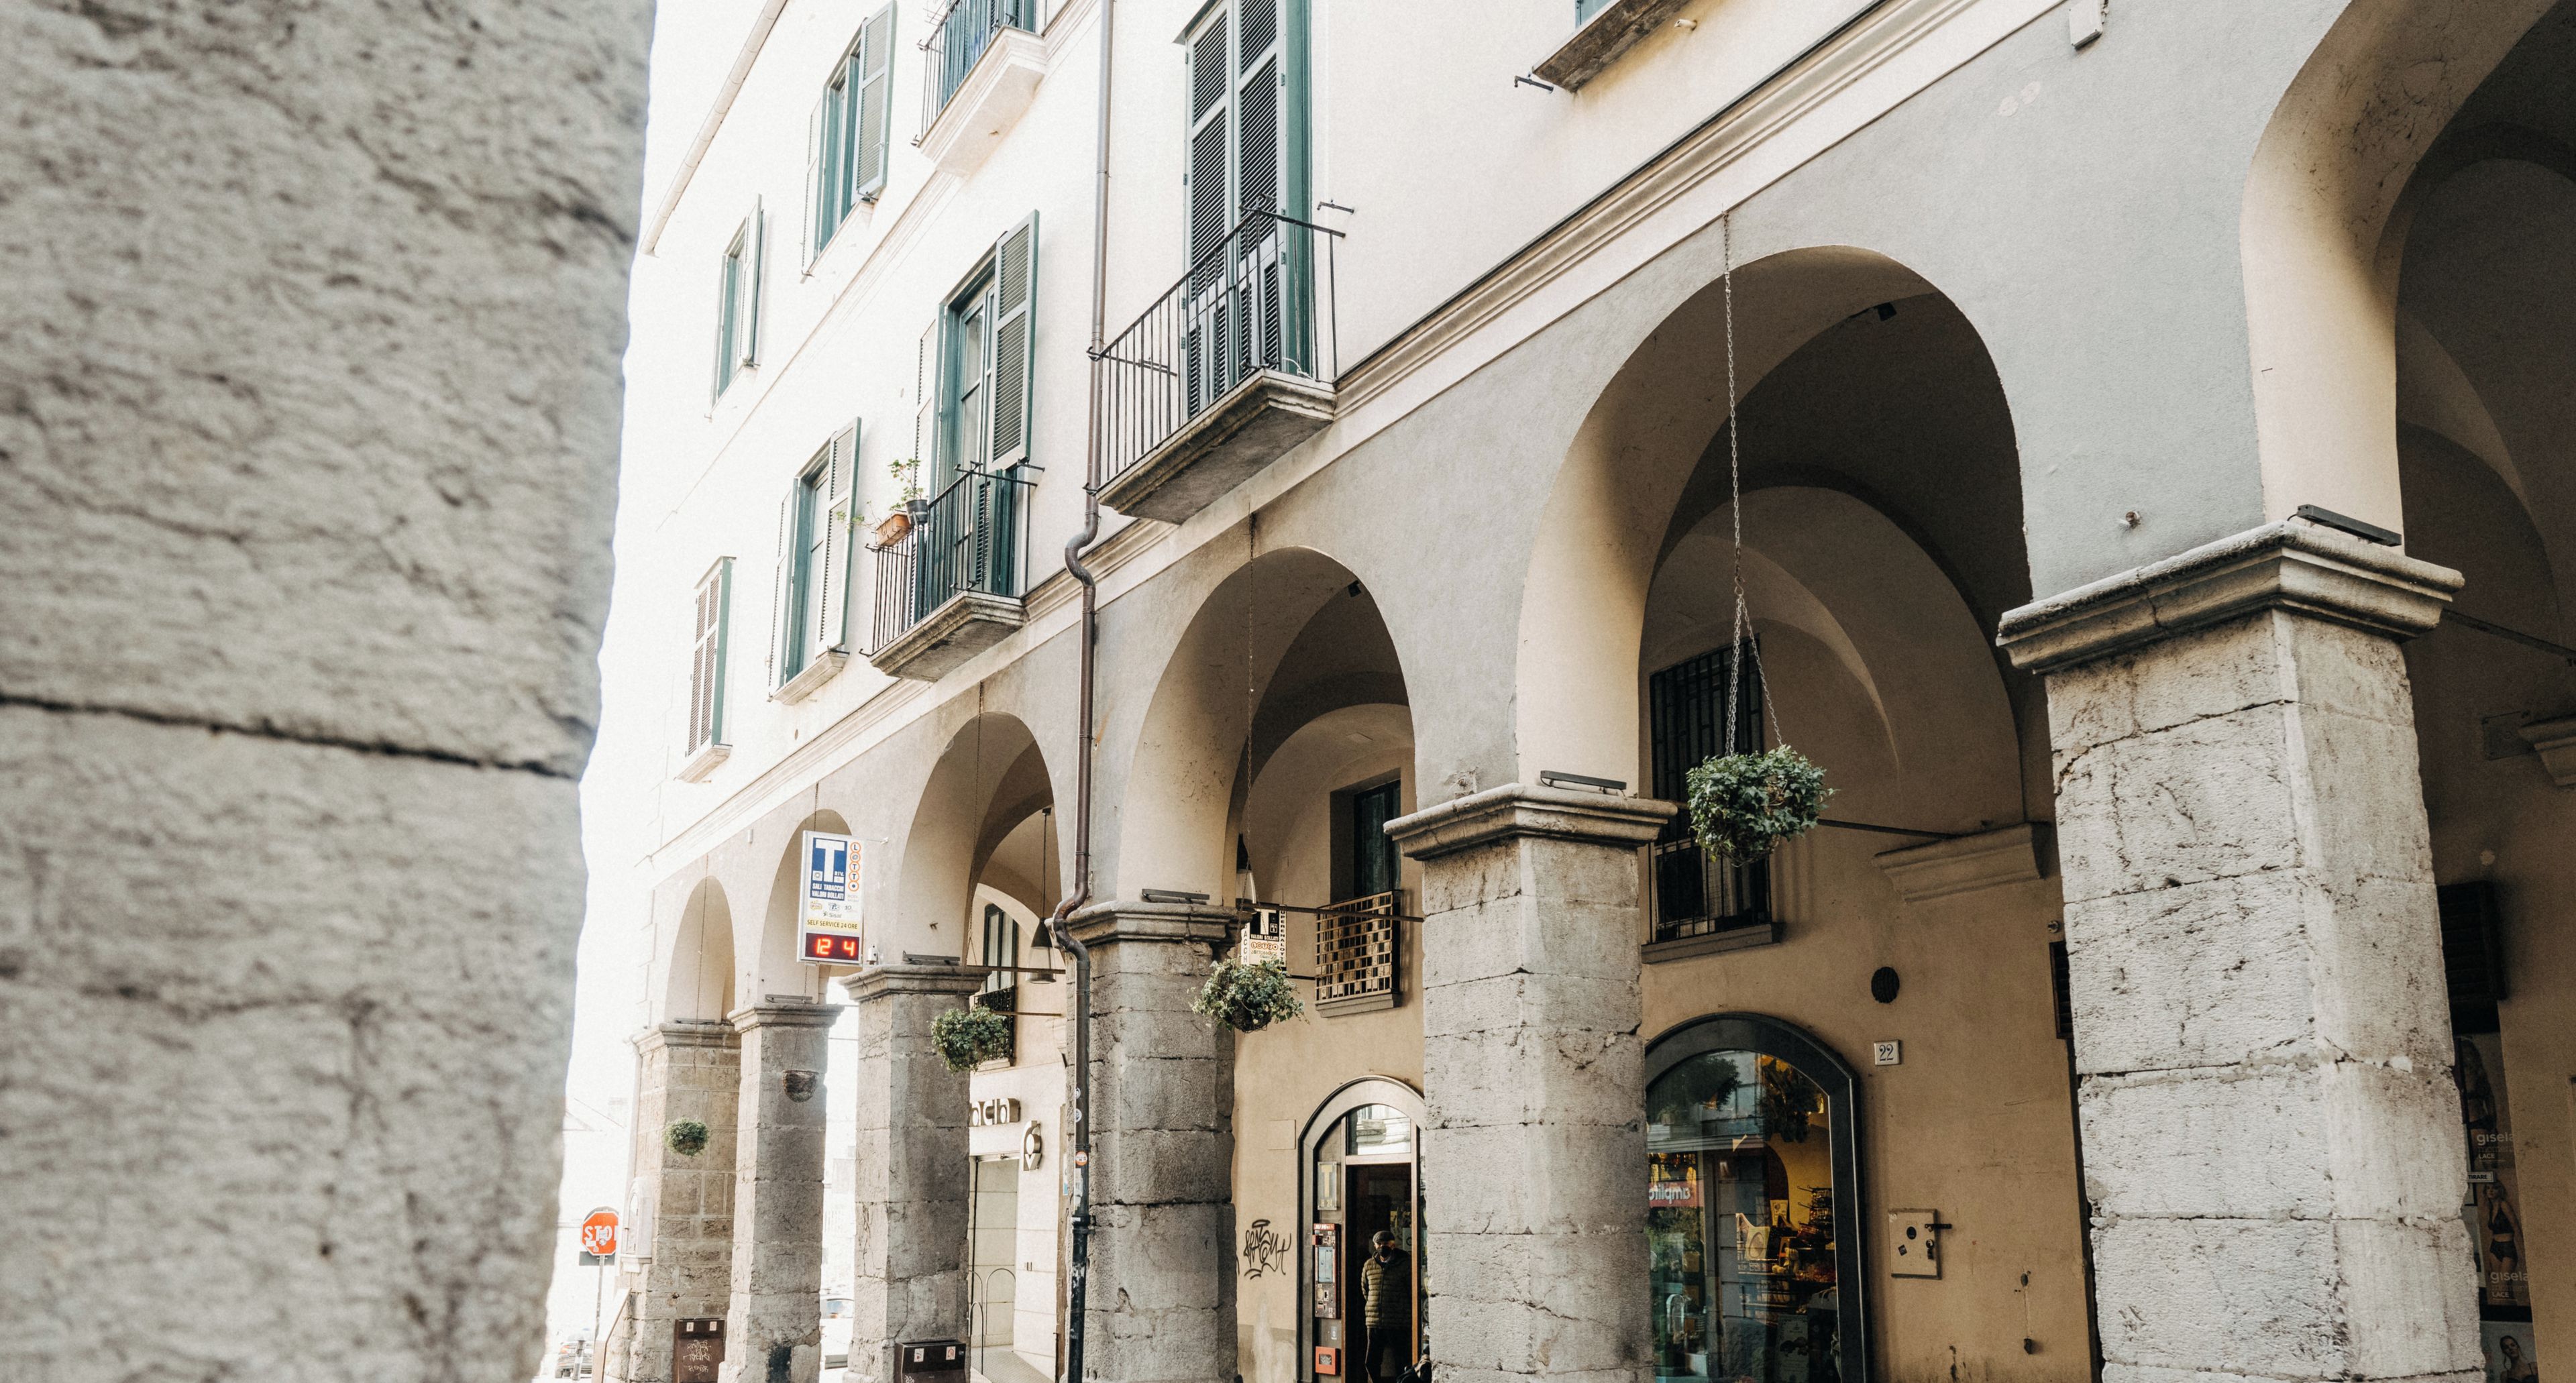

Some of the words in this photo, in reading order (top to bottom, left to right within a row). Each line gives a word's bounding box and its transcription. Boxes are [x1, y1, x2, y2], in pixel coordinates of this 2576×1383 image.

[815, 838, 845, 883] T
[823, 883, 844, 892] TABACCHI
[812, 890, 827, 898] VALORI
[827, 891, 844, 899] BOLLATI
[816, 938, 832, 956] 12
[1879, 1044, 1894, 1061] 22
[1326, 1199, 1333, 1207] 24
[2489, 1271, 2529, 1284] gisela
